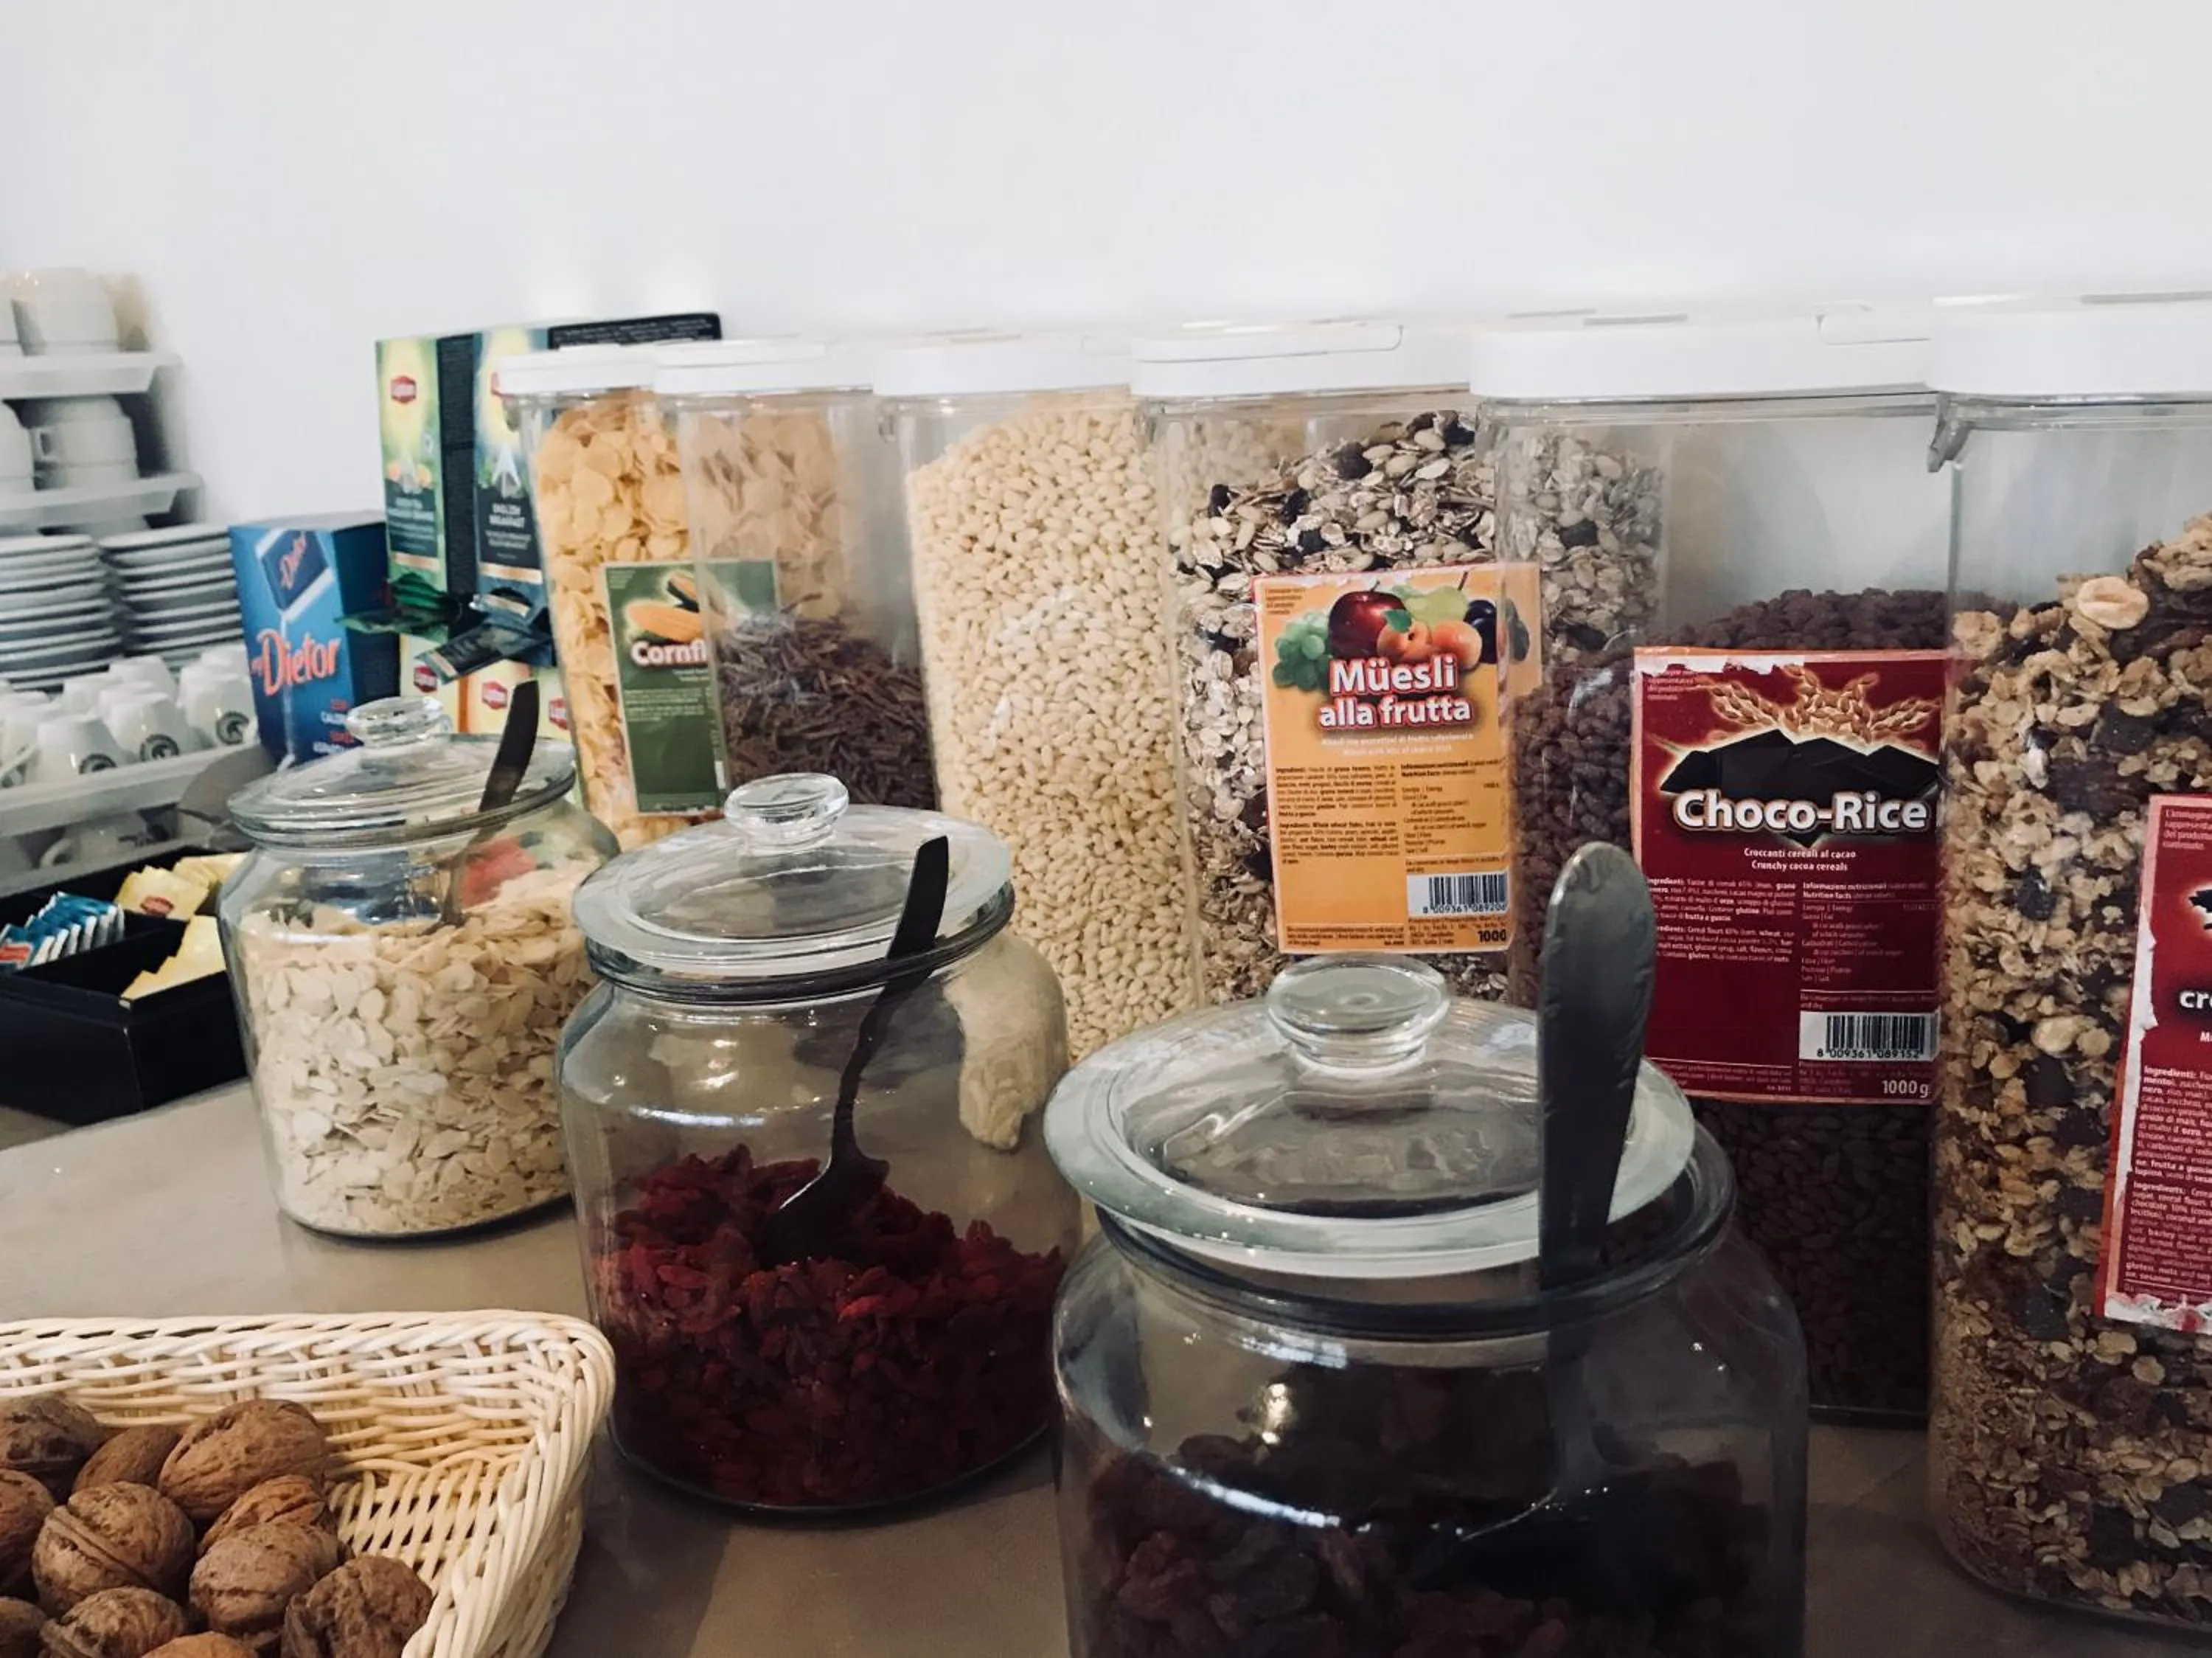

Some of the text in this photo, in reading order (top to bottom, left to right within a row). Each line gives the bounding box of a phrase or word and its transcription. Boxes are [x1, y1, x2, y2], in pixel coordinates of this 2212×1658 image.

[257, 627, 341, 697] Dietor
[1330, 653, 1458, 695] Müesli
[1318, 696, 1473, 729] alla frutta
[1676, 790, 1927, 831] Choco-Rice
[1744, 847, 1857, 860] Croccanti cereali al cacao
[1751, 859, 1848, 873] Crunchy cocoa cereals
[1803, 892, 1834, 900] Nutrition
[1422, 906, 1429, 914] 8
[2179, 990, 2212, 1010] cr
[1817, 1047, 1920, 1060] 8 009361 089152
[1882, 1079, 1930, 1098] 1000 g
